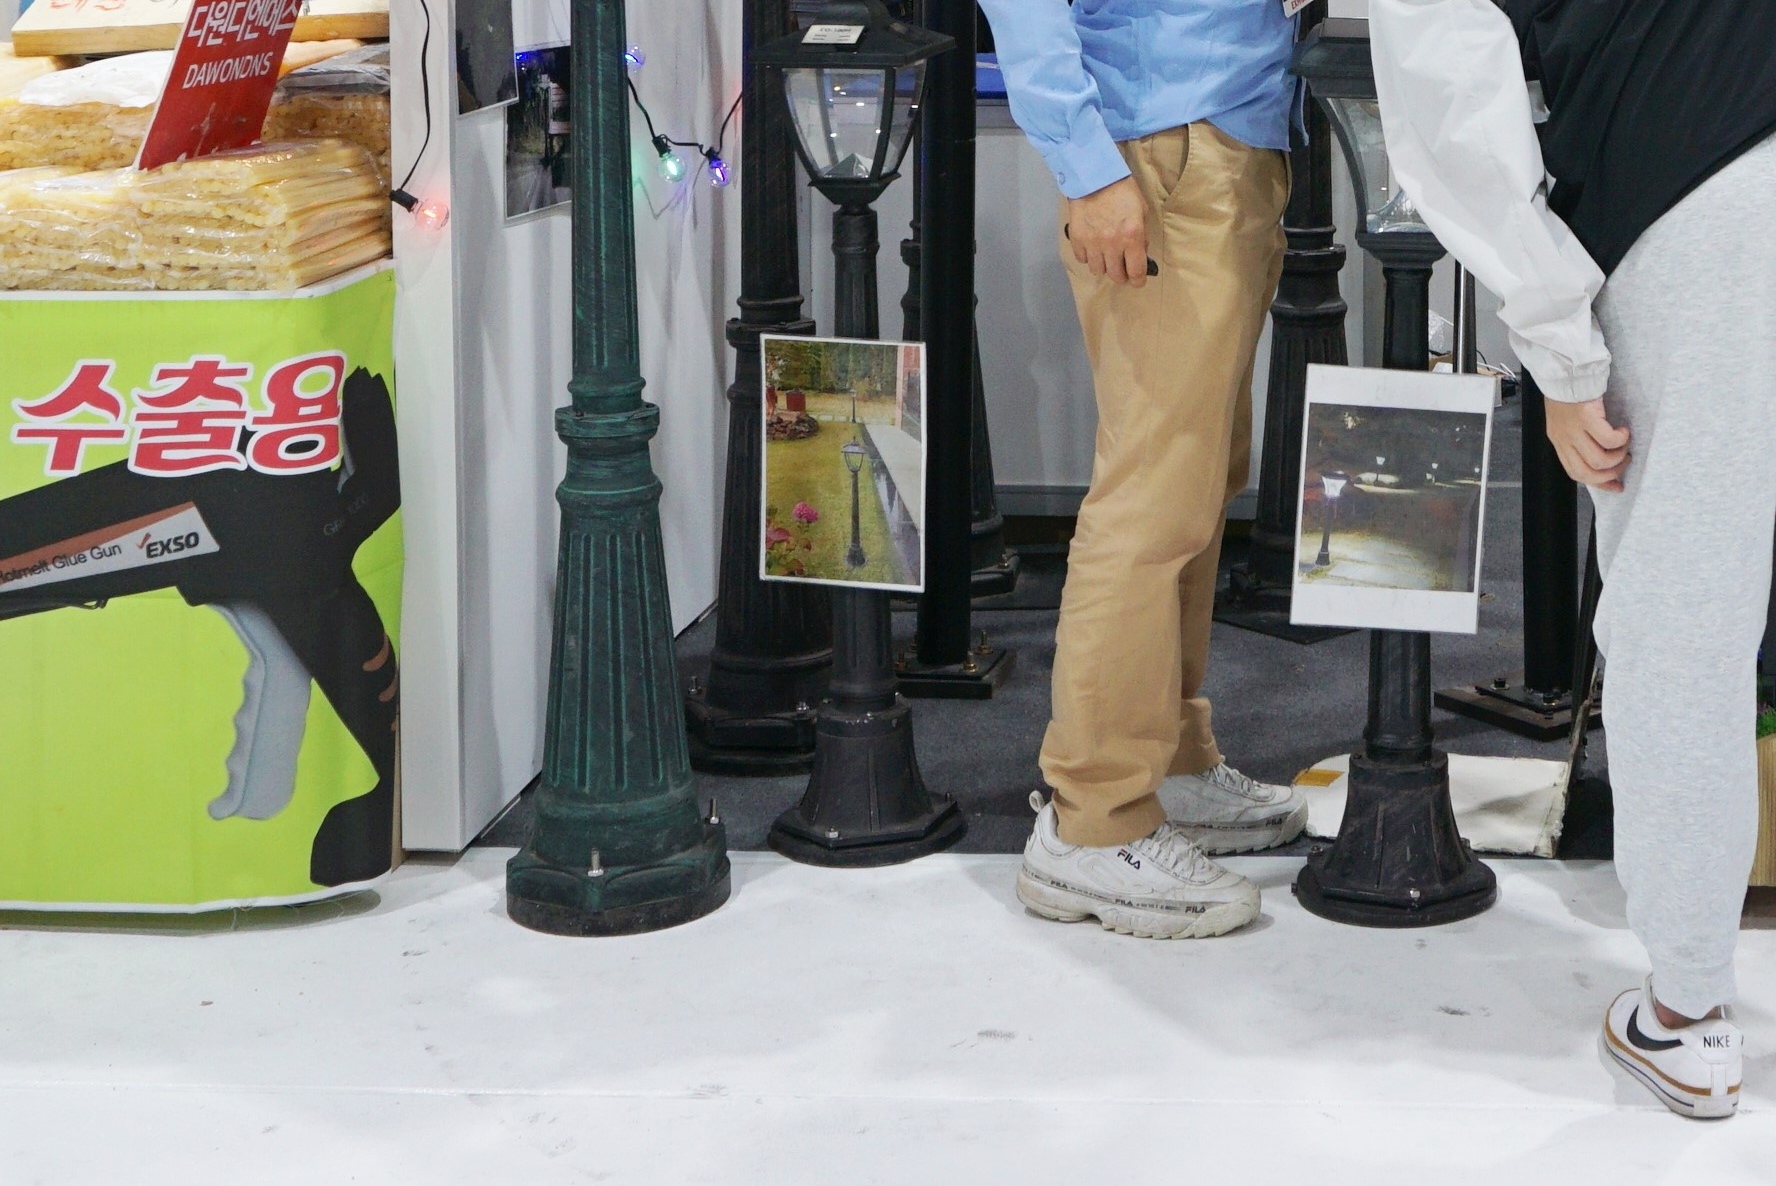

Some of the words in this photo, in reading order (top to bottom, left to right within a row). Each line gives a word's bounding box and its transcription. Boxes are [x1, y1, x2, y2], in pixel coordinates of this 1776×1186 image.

[182, 51, 274, 90] DAWONDNS
[13, 355, 346, 475] 수출용
[52, 551, 88, 571] Glue
[90, 542, 123, 560] Gun
[145, 531, 200, 559] EXSO
[1117, 848, 1141, 871] FILA
[1185, 905, 1206, 914] FILA
[1703, 1034, 1732, 1050] NIKE
